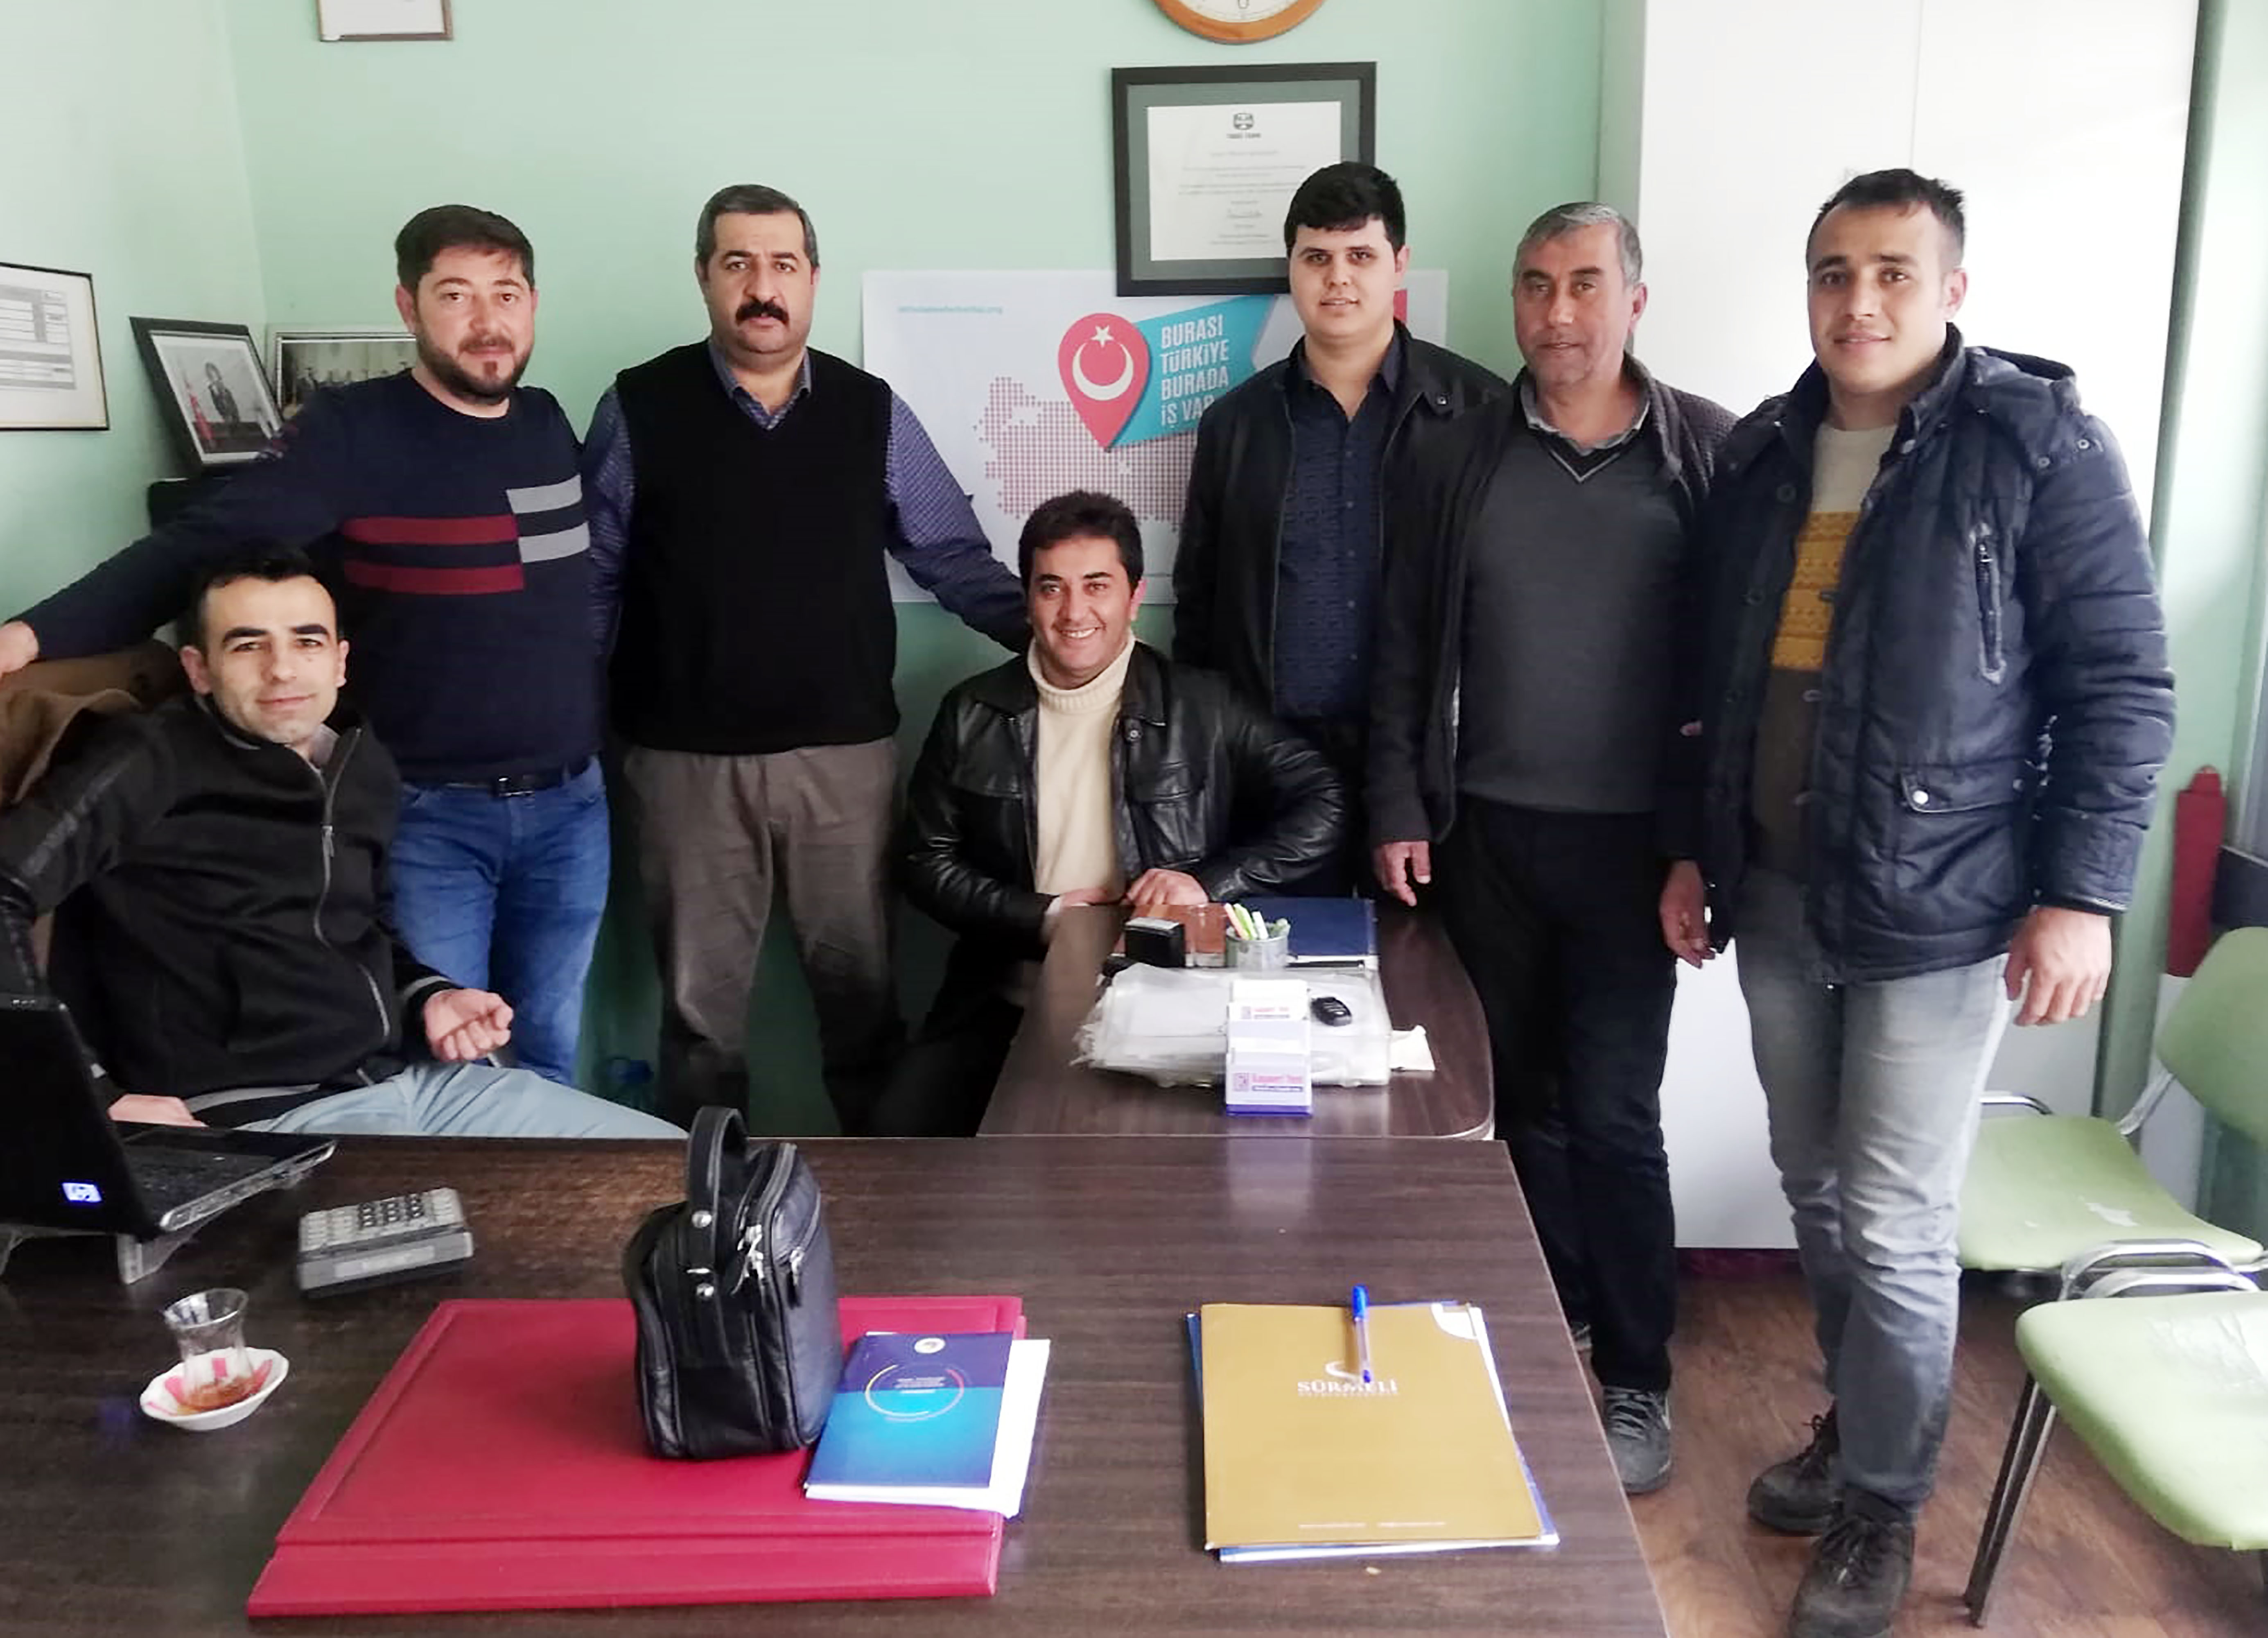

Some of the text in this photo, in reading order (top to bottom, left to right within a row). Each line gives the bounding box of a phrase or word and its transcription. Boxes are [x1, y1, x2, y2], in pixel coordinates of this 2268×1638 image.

[1161, 314, 1223, 348] BURASI
[1160, 339, 1229, 374] TÜRKİYE
[1161, 366, 1228, 400] BURADA
